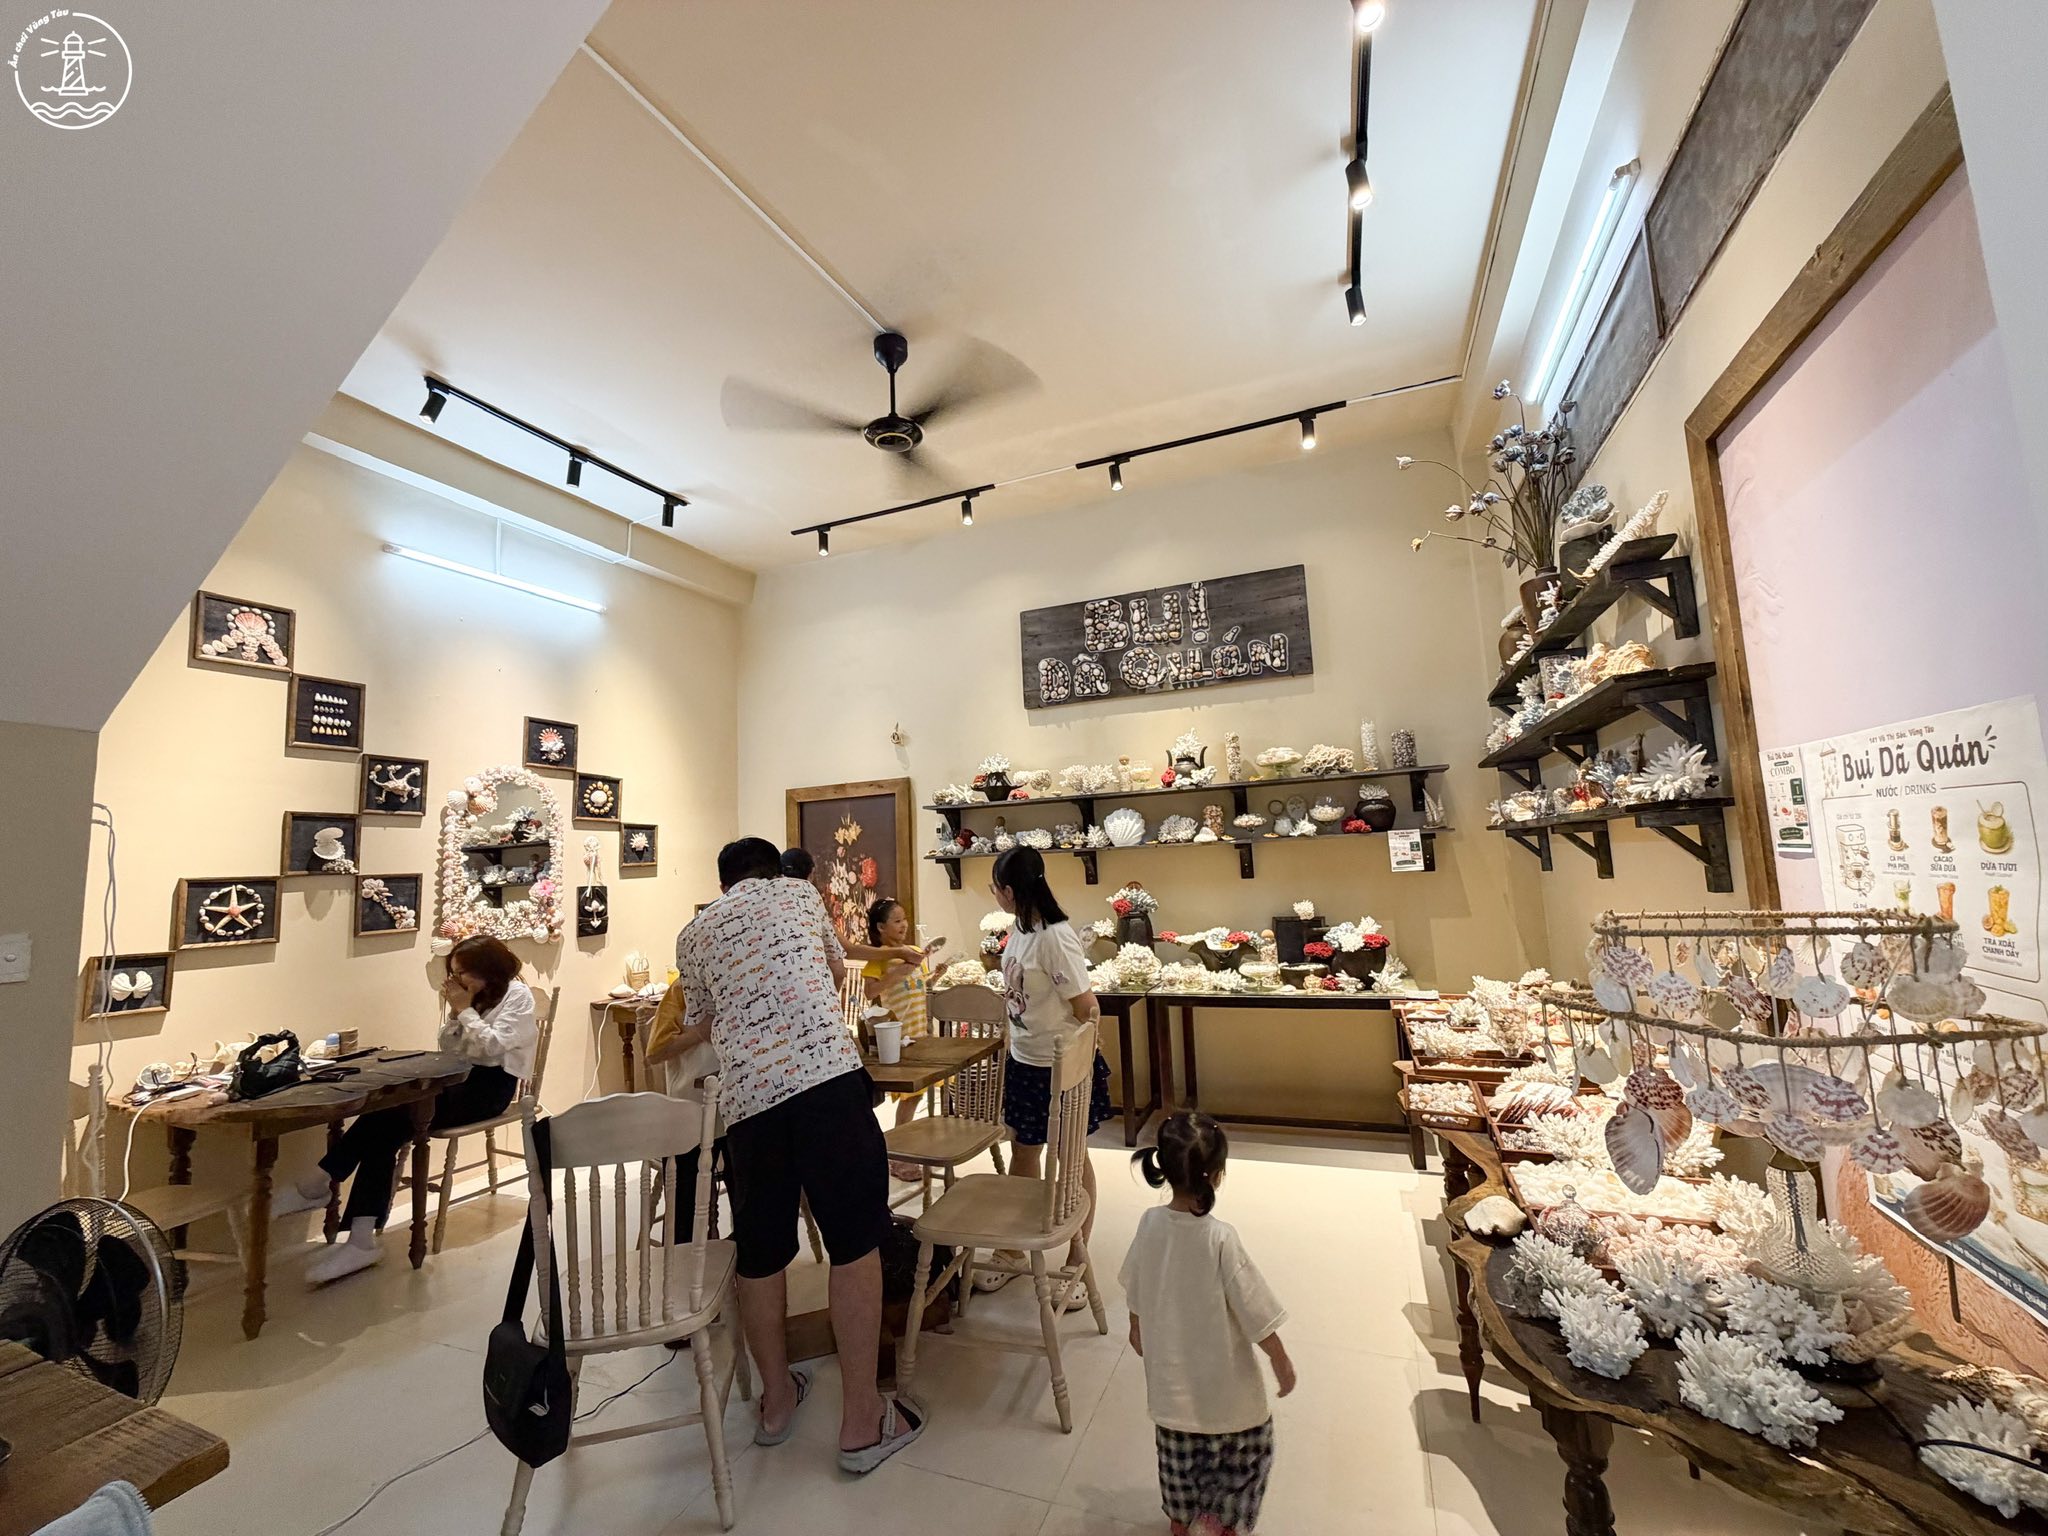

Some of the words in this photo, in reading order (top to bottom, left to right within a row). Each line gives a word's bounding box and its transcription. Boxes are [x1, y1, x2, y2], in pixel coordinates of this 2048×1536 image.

[1842, 750, 1874, 789] Bụi
[1879, 743, 1910, 777] Dã
[1916, 734, 1989, 774] Quán
[1770, 765, 1796, 777] COMBO
[1876, 785, 1899, 798] NƯỚC
[1905, 783, 1937, 796] DRINKS
[1933, 855, 1954, 863] CACAO
